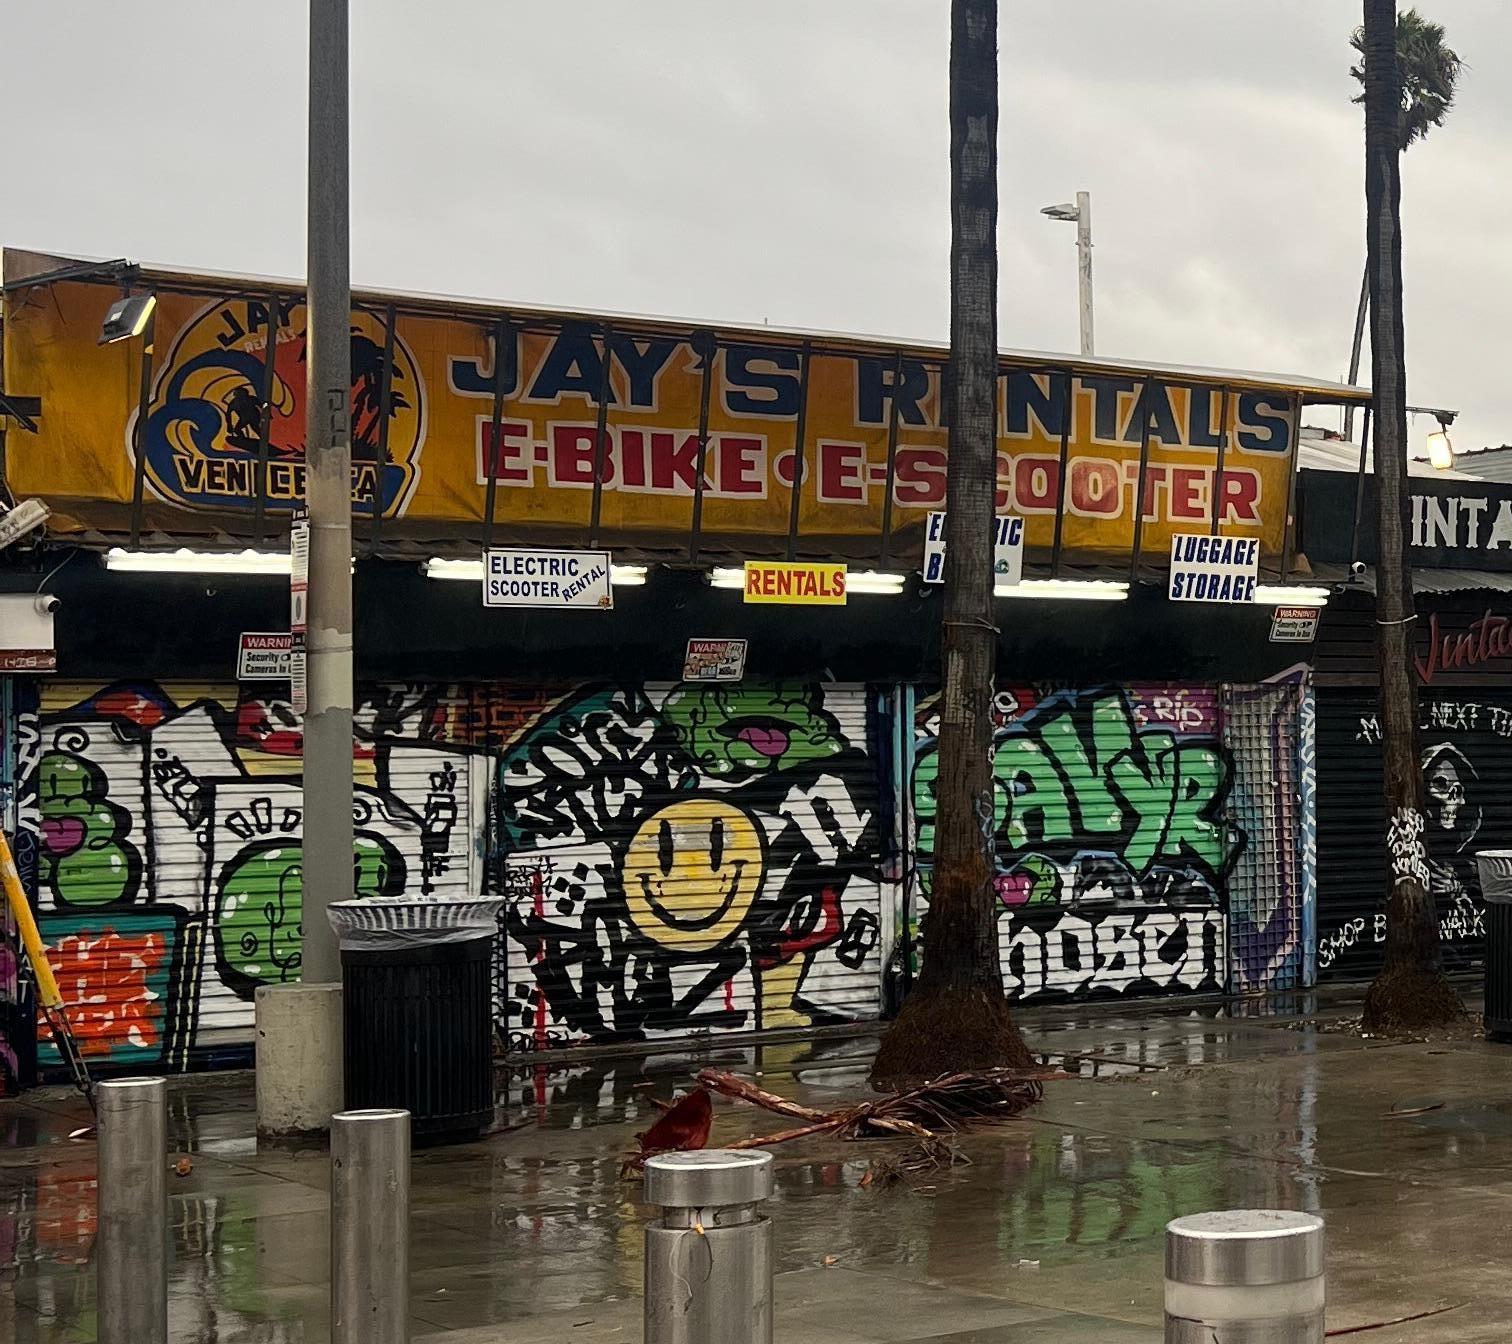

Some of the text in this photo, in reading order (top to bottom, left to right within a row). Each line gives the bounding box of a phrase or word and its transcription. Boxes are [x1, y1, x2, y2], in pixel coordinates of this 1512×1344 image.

[449, 322, 803, 420] JAY'S
[855, 356, 1292, 454] RNTALS
[478, 416, 1264, 526] E-BIKE E-SOOTER
[491, 555, 579, 577] ELECTRIC
[1173, 536, 1259, 566] LUGGAGE
[490, 564, 606, 603] SCOOTER RENTAL
[746, 568, 846, 598] RENTALS
[1171, 572, 1256, 601] STORAGE
[246, 637, 292, 648] WARNI
[1318, 916, 1365, 968] SHOP
